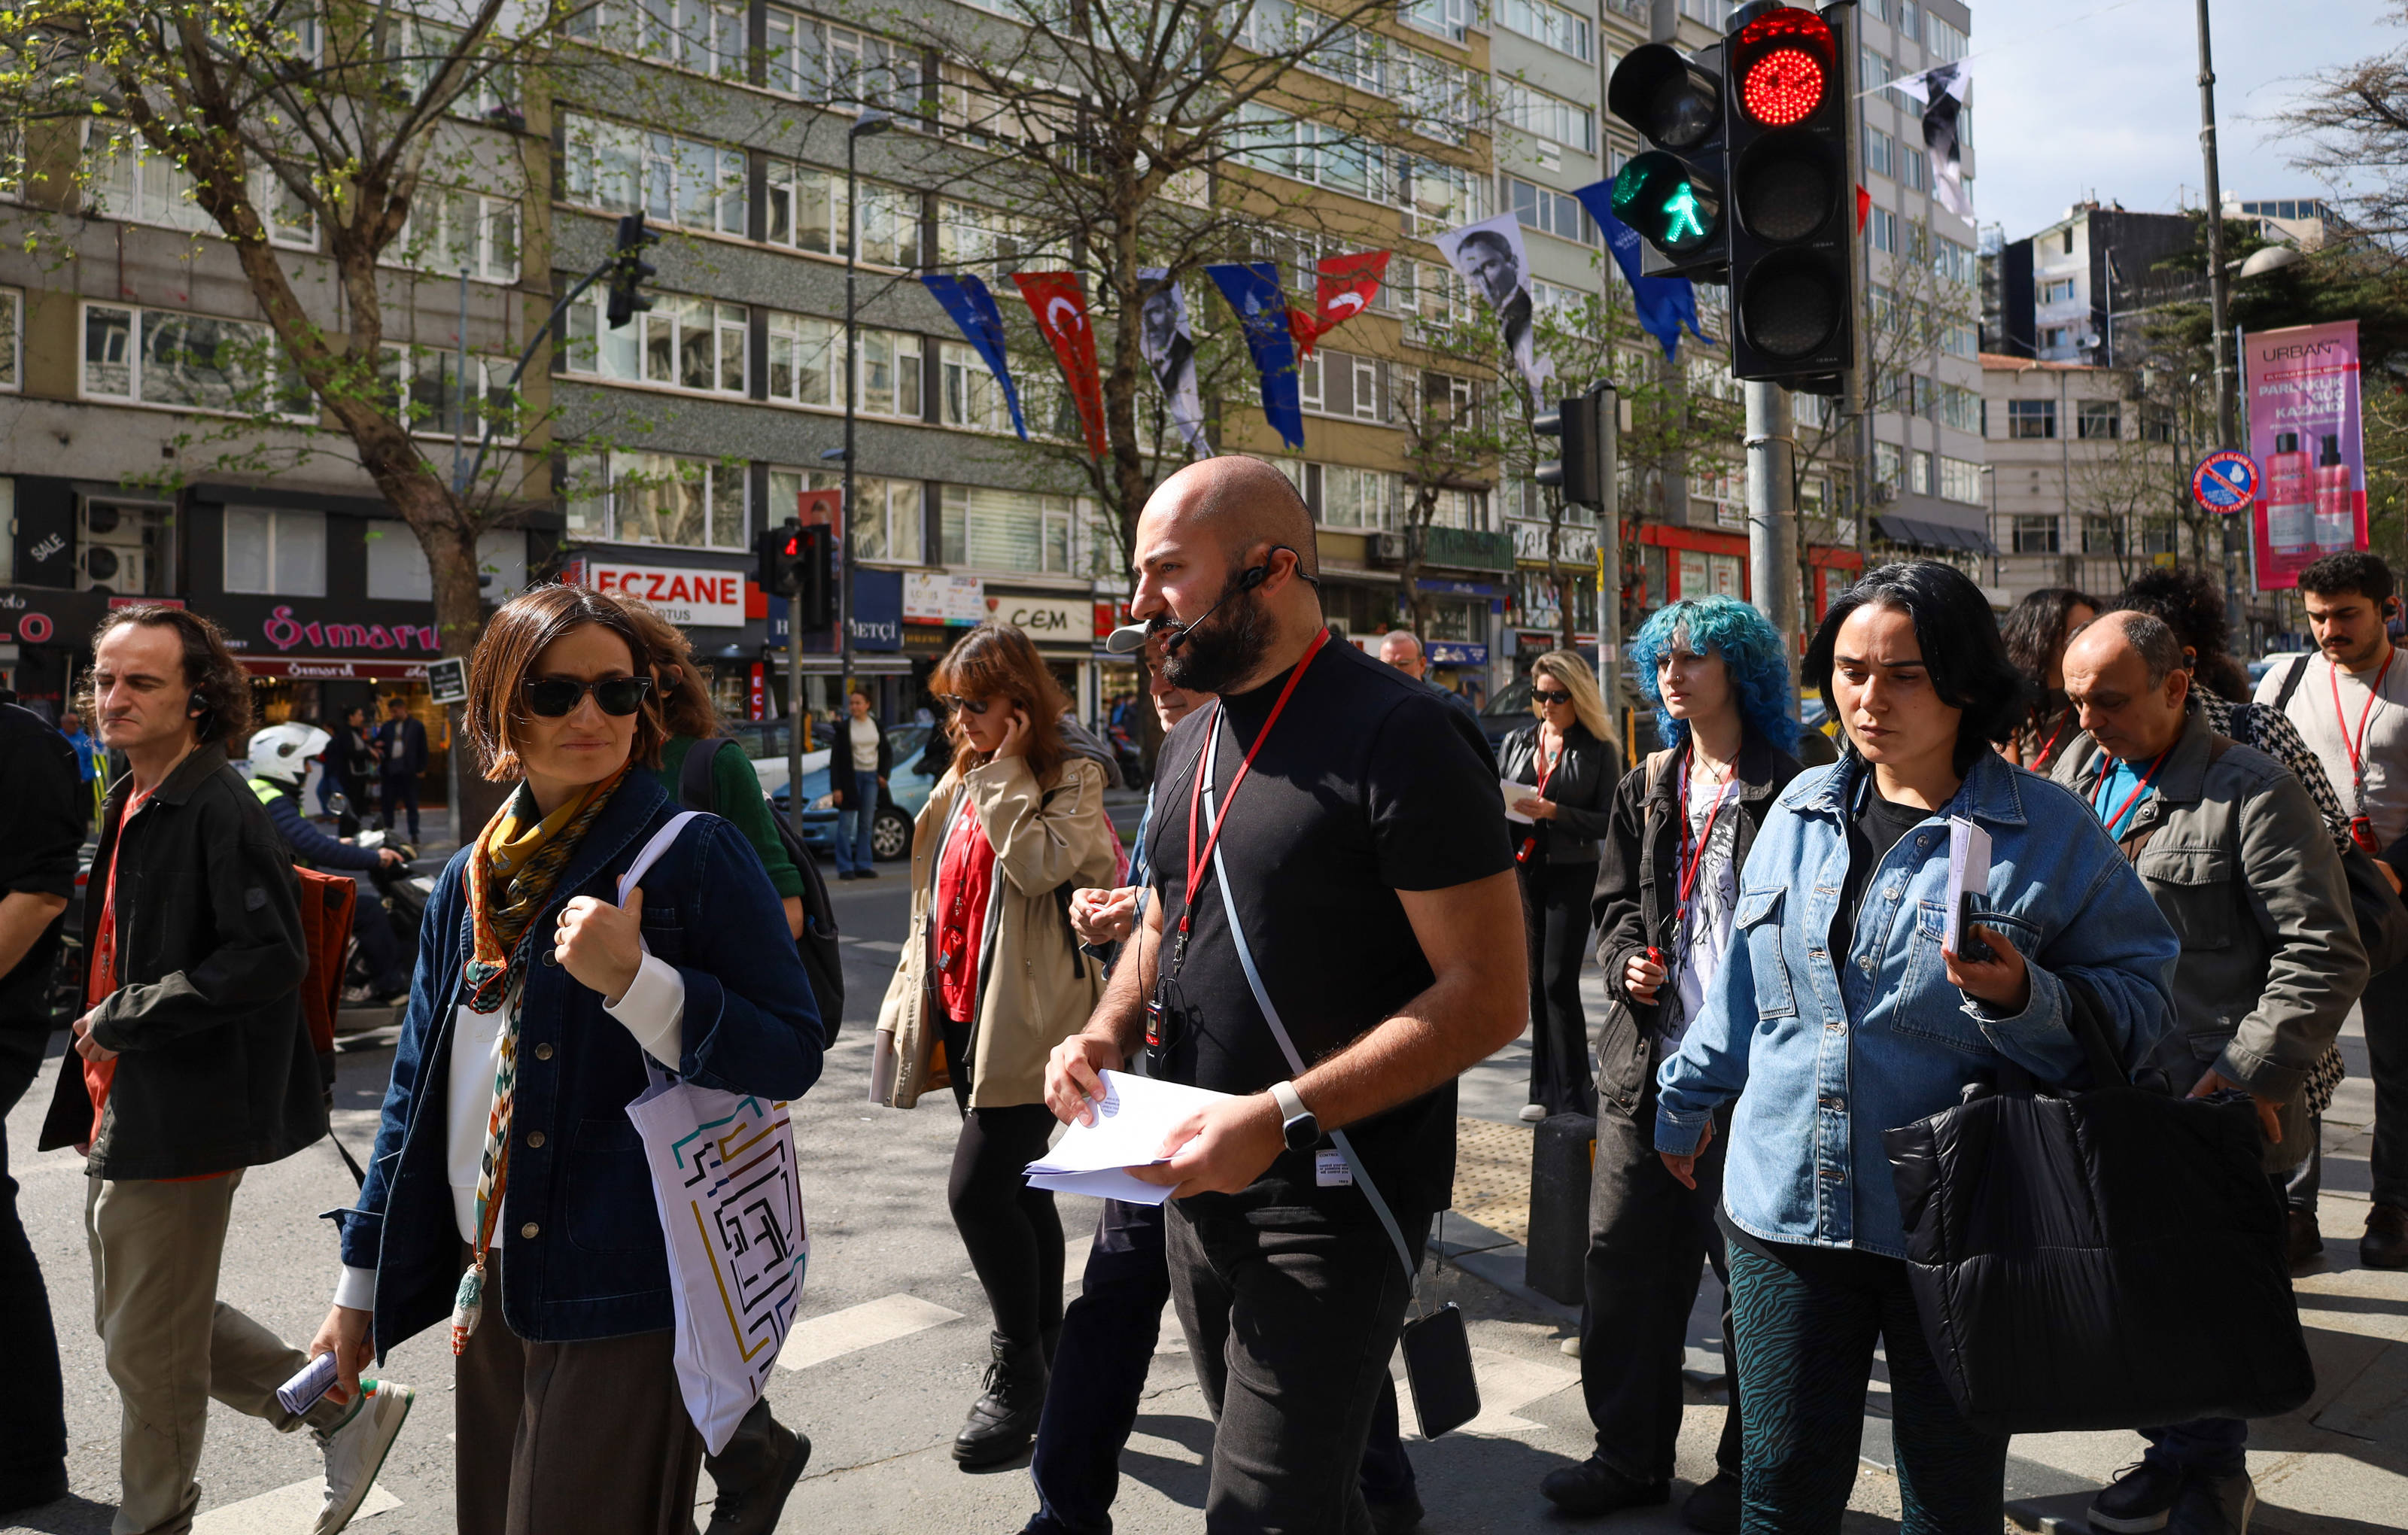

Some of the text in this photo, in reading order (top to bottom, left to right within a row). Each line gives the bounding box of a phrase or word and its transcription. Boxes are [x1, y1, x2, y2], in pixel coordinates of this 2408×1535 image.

[2263, 344, 2331, 362] URBAN
[2258, 377, 2343, 397] PARLAKLIK
[31, 532, 65, 562] SALE
[599, 571, 738, 605] ECZANE
[1011, 609, 1069, 631] CEM
